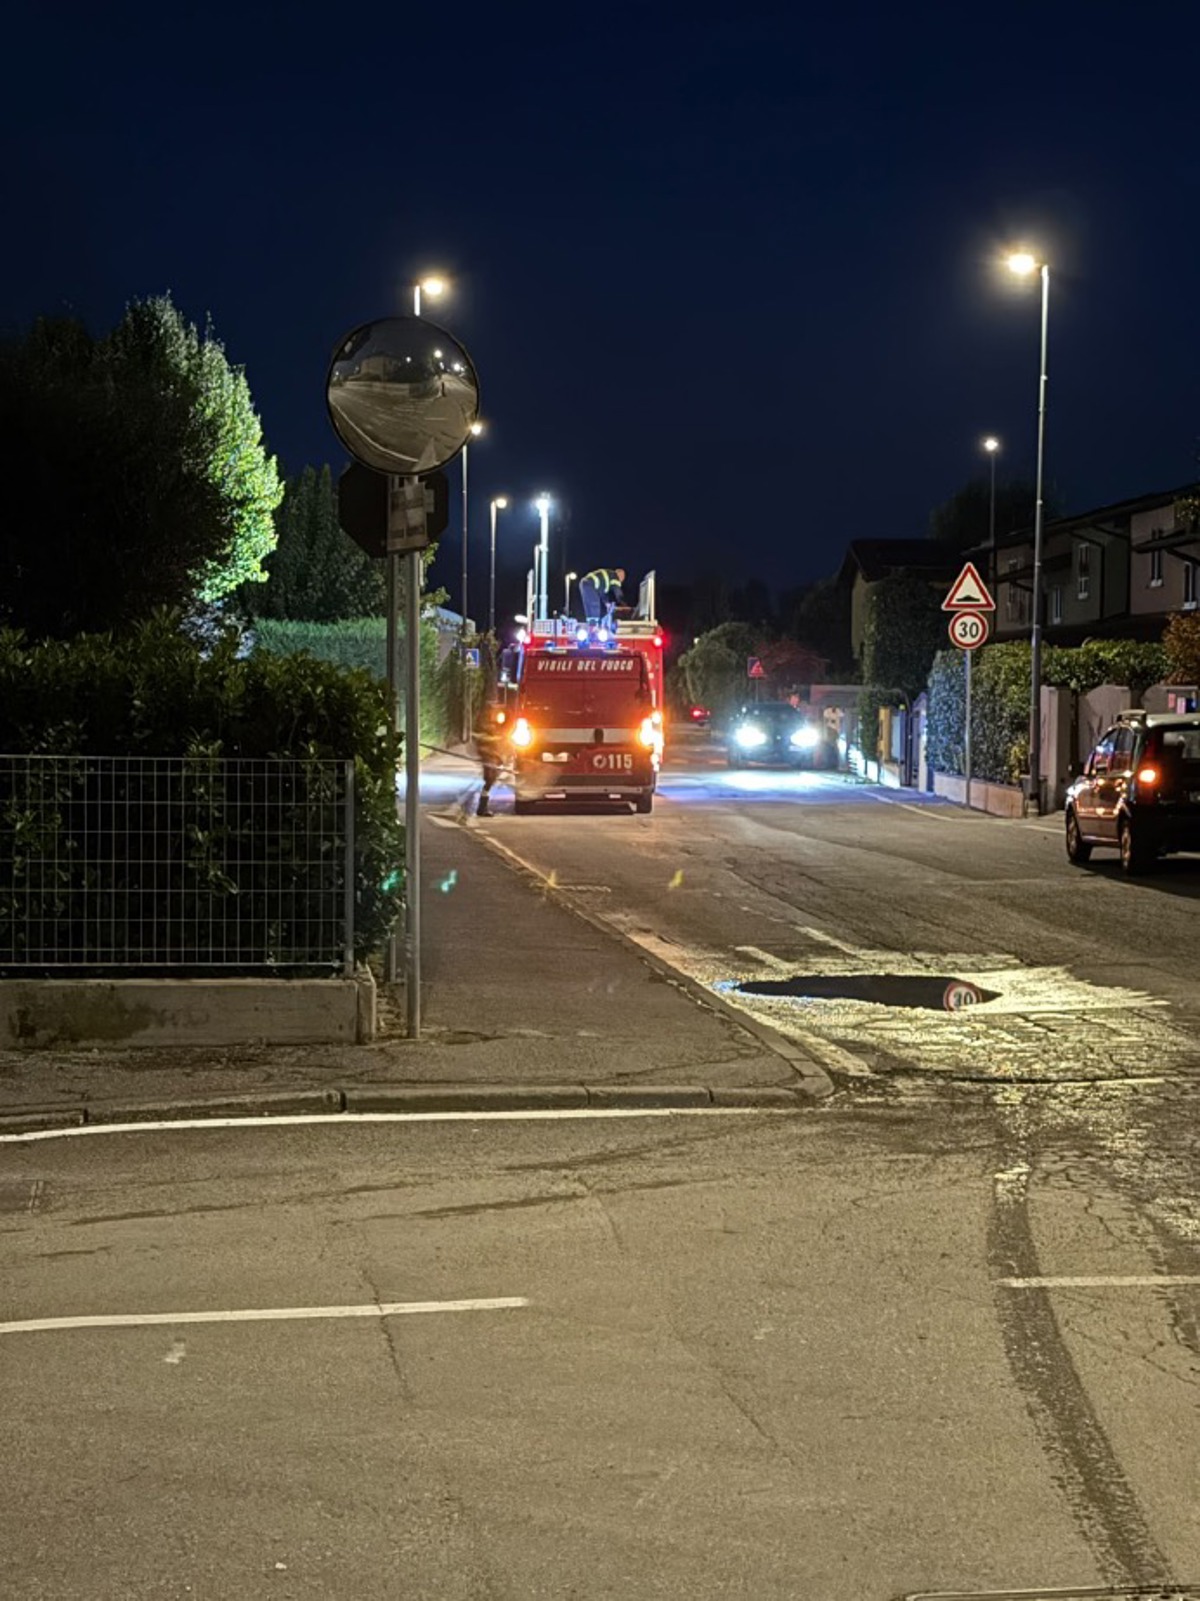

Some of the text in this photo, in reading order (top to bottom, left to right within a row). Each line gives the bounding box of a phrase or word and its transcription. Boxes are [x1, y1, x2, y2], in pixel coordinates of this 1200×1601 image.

[958, 621, 979, 639] 30
[577, 660, 596, 671] DEL
[601, 660, 634, 671] FUOCO
[609, 753, 632, 769] 115
